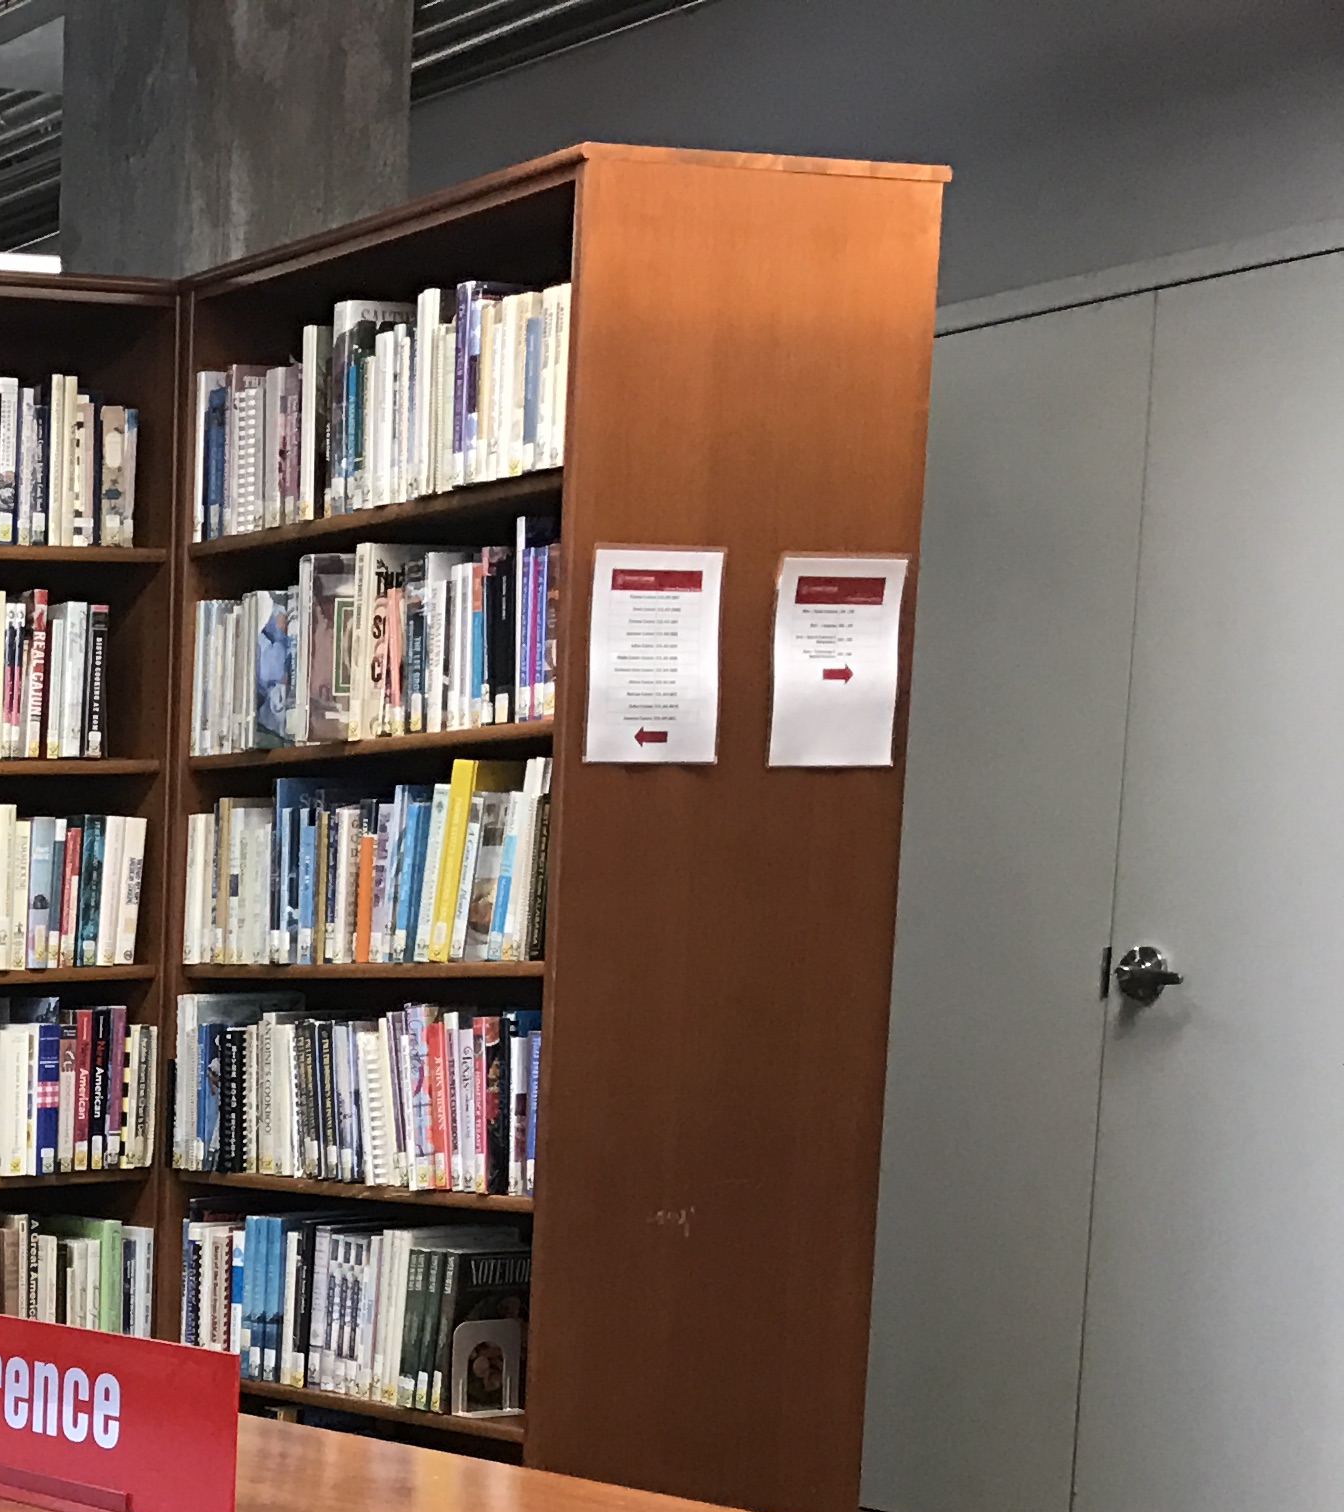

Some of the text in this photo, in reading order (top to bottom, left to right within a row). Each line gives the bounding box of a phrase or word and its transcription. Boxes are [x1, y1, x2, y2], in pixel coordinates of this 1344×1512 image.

[94, 637, 103, 666] BISTRO
[31, 631, 46, 713] REAL CAJUN
[93, 667, 102, 701] COOKING
[92, 714, 100, 731] HOM
[77, 1068, 89, 1119] American
[92, 1067, 105, 1118] American
[28, 1233, 40, 1267] Great
[28, 1272, 38, 1318] Americ
